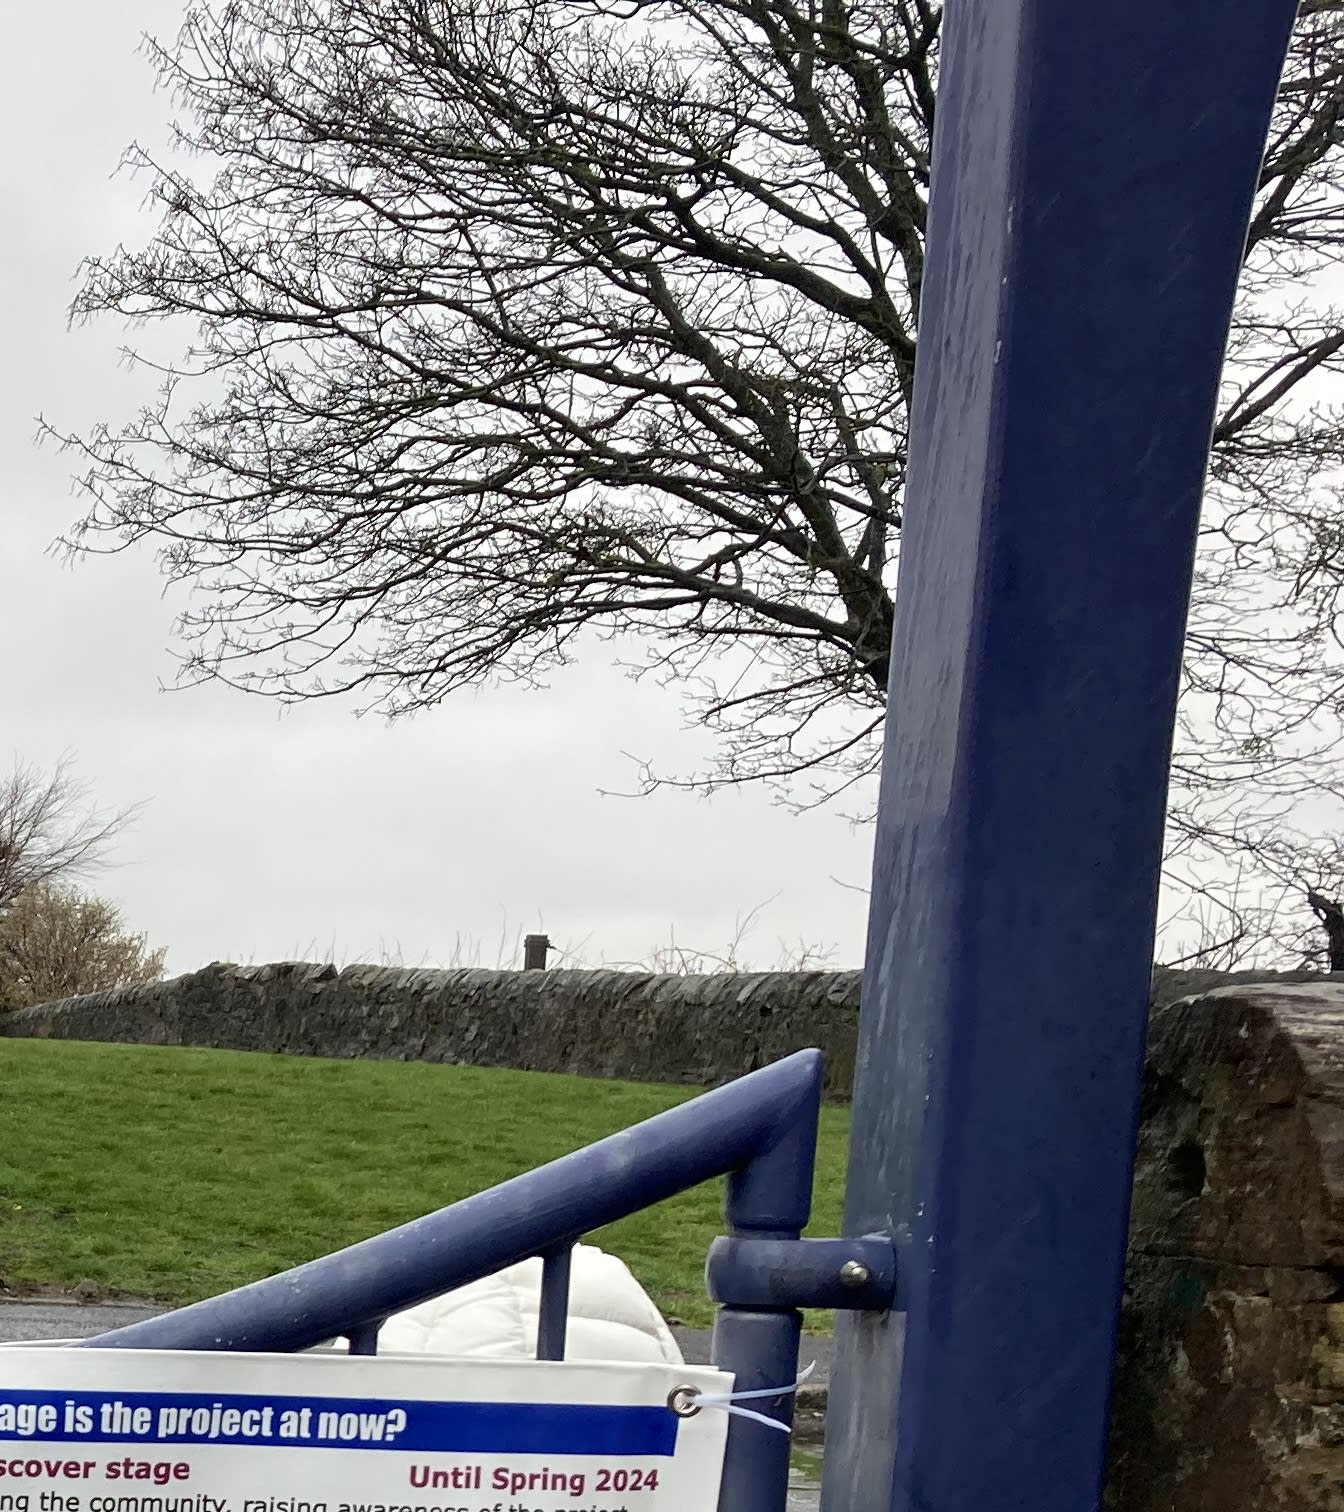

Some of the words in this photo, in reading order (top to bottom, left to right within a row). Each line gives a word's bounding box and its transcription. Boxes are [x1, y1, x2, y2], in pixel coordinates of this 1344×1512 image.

[63, 1399, 94, 1434] is
[99, 1400, 152, 1435] the
[157, 1402, 275, 1439] project
[278, 1407, 313, 1439] at
[317, 1408, 407, 1442] now?
[104, 1457, 190, 1486] stage
[409, 1465, 482, 1490] Until
[491, 1467, 586, 1498] Spring
[594, 1468, 660, 1492] 2024
[39, 1490, 80, 1512] the
